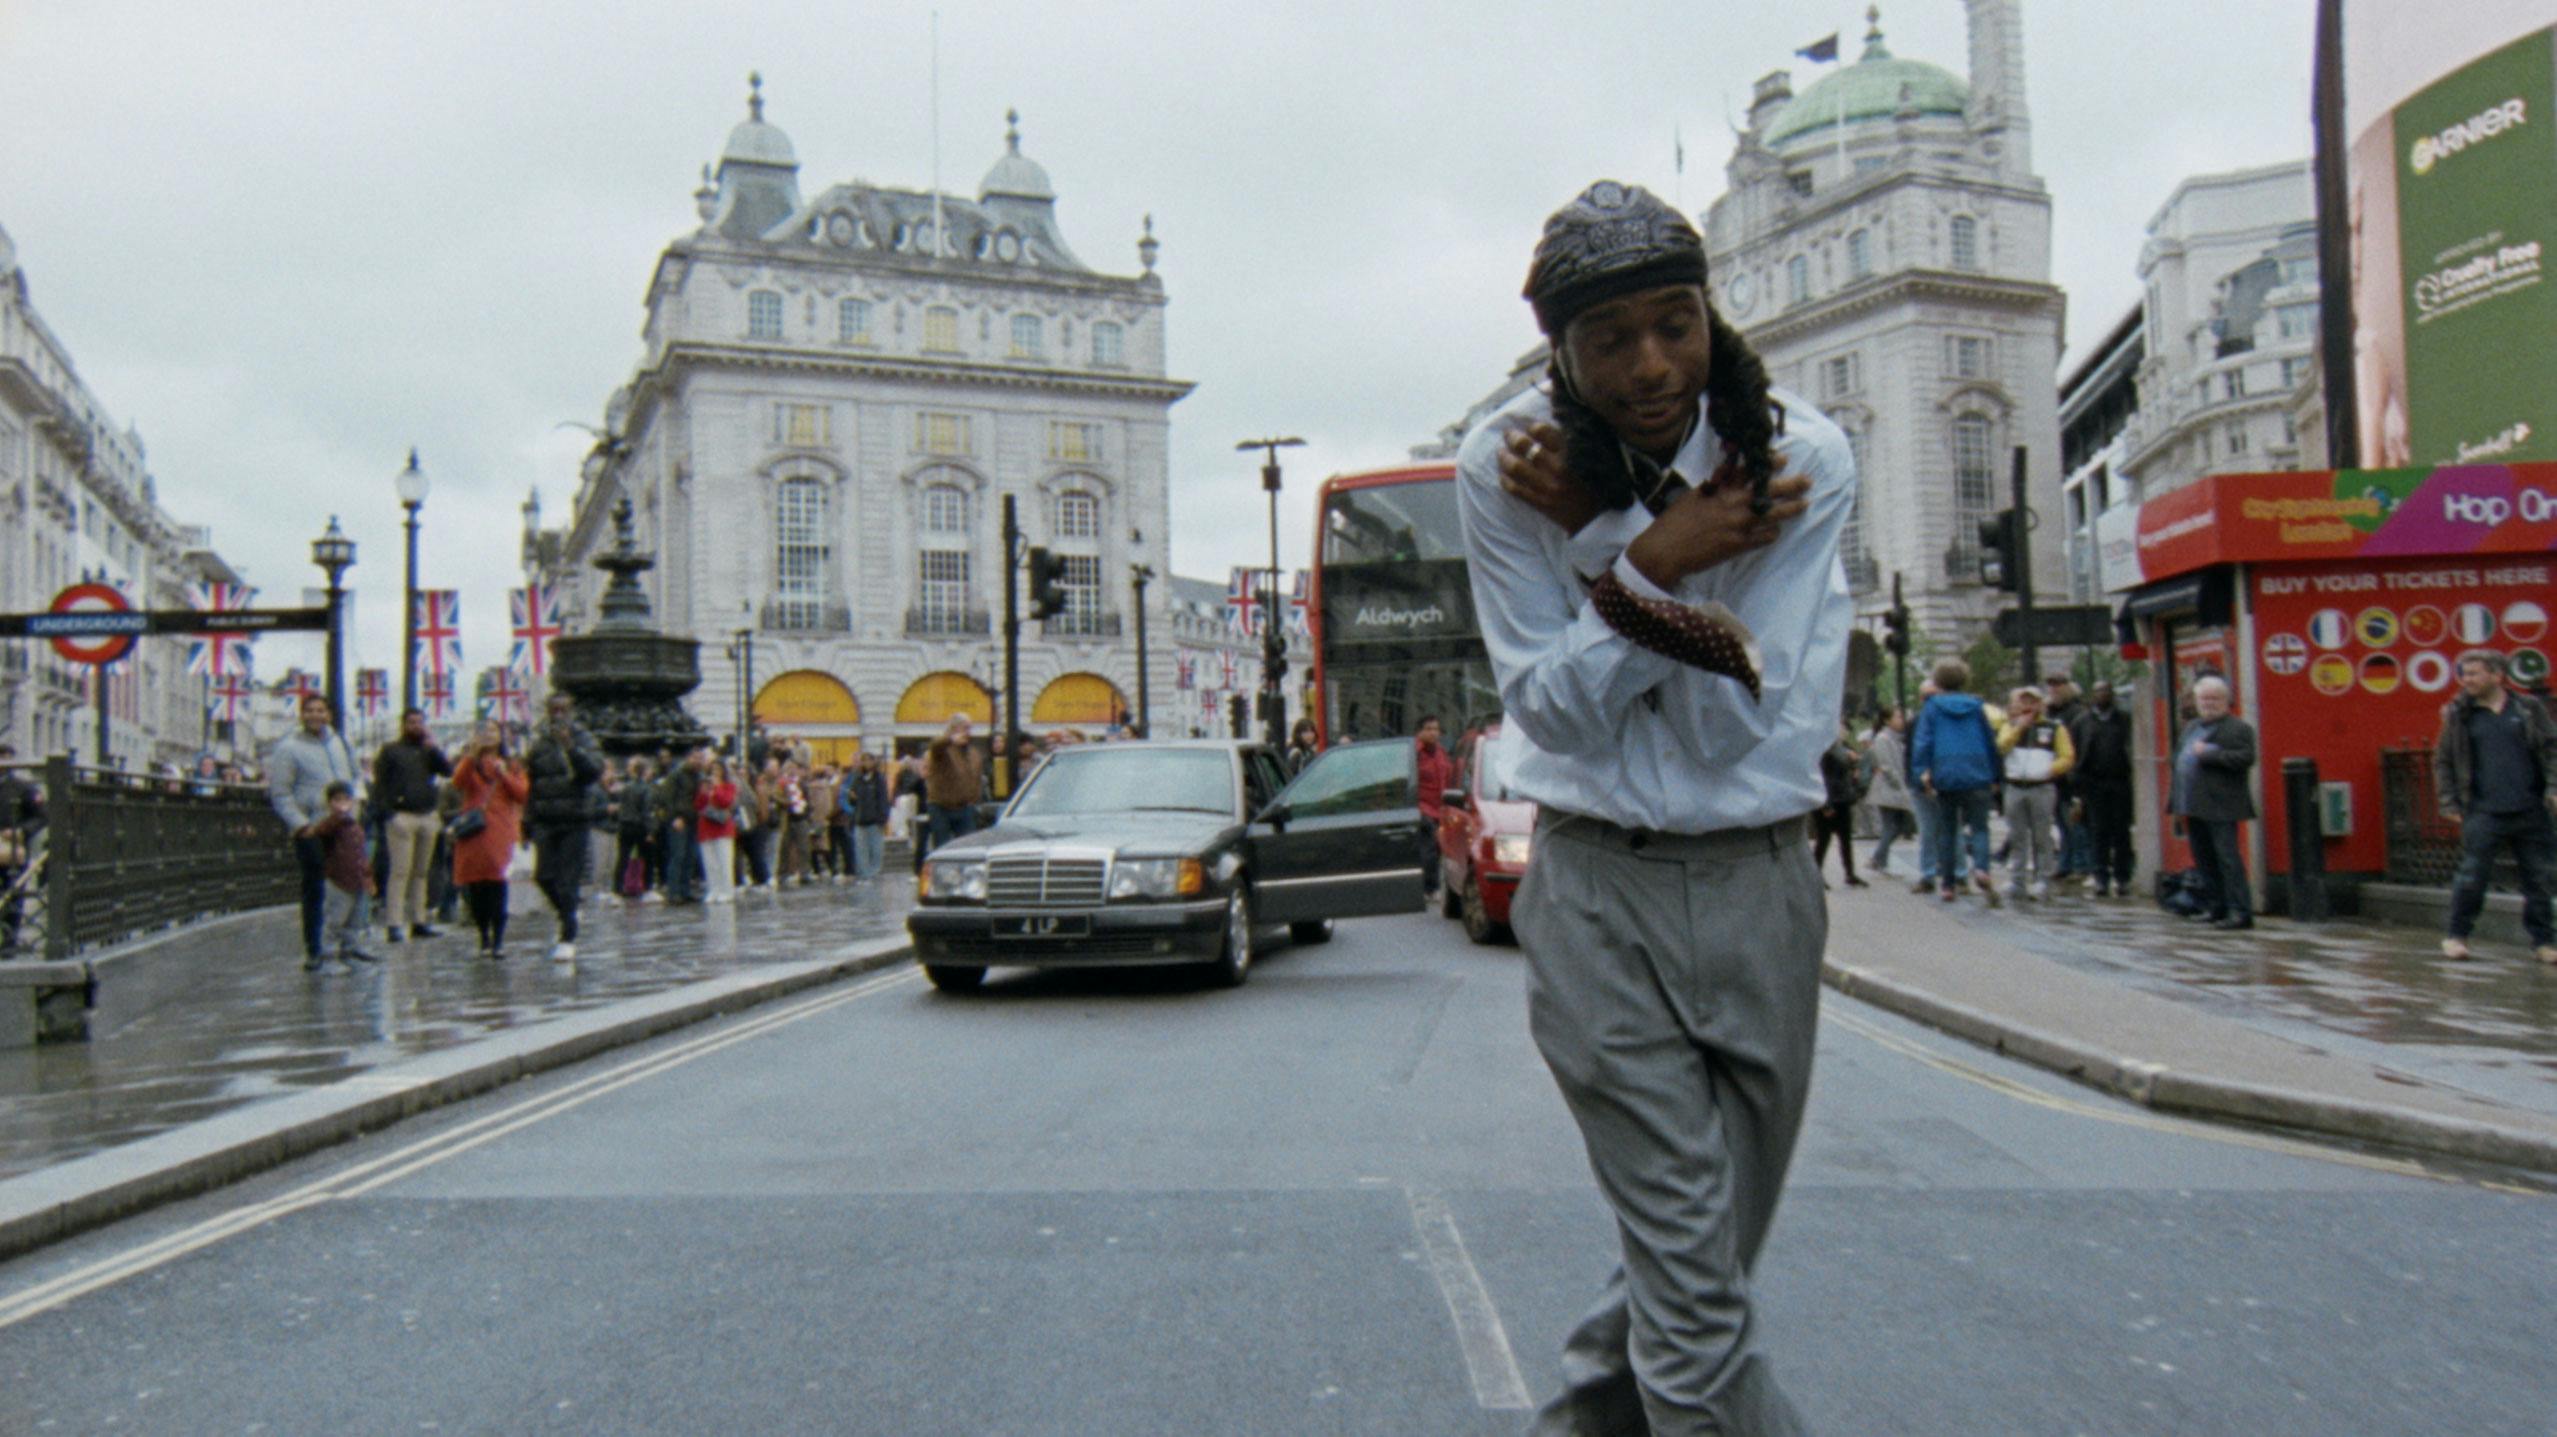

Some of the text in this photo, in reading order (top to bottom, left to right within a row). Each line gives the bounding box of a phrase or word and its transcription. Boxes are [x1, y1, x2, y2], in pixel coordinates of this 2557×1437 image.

[2411, 98, 2527, 174] GARNIER
[2443, 492, 2511, 527] Hop
[2261, 566, 2549, 594] BUY YOUR TICKETS HERE
[33, 614, 147, 633] UNDERGROUND
[1355, 604, 1444, 628] Aldwych
